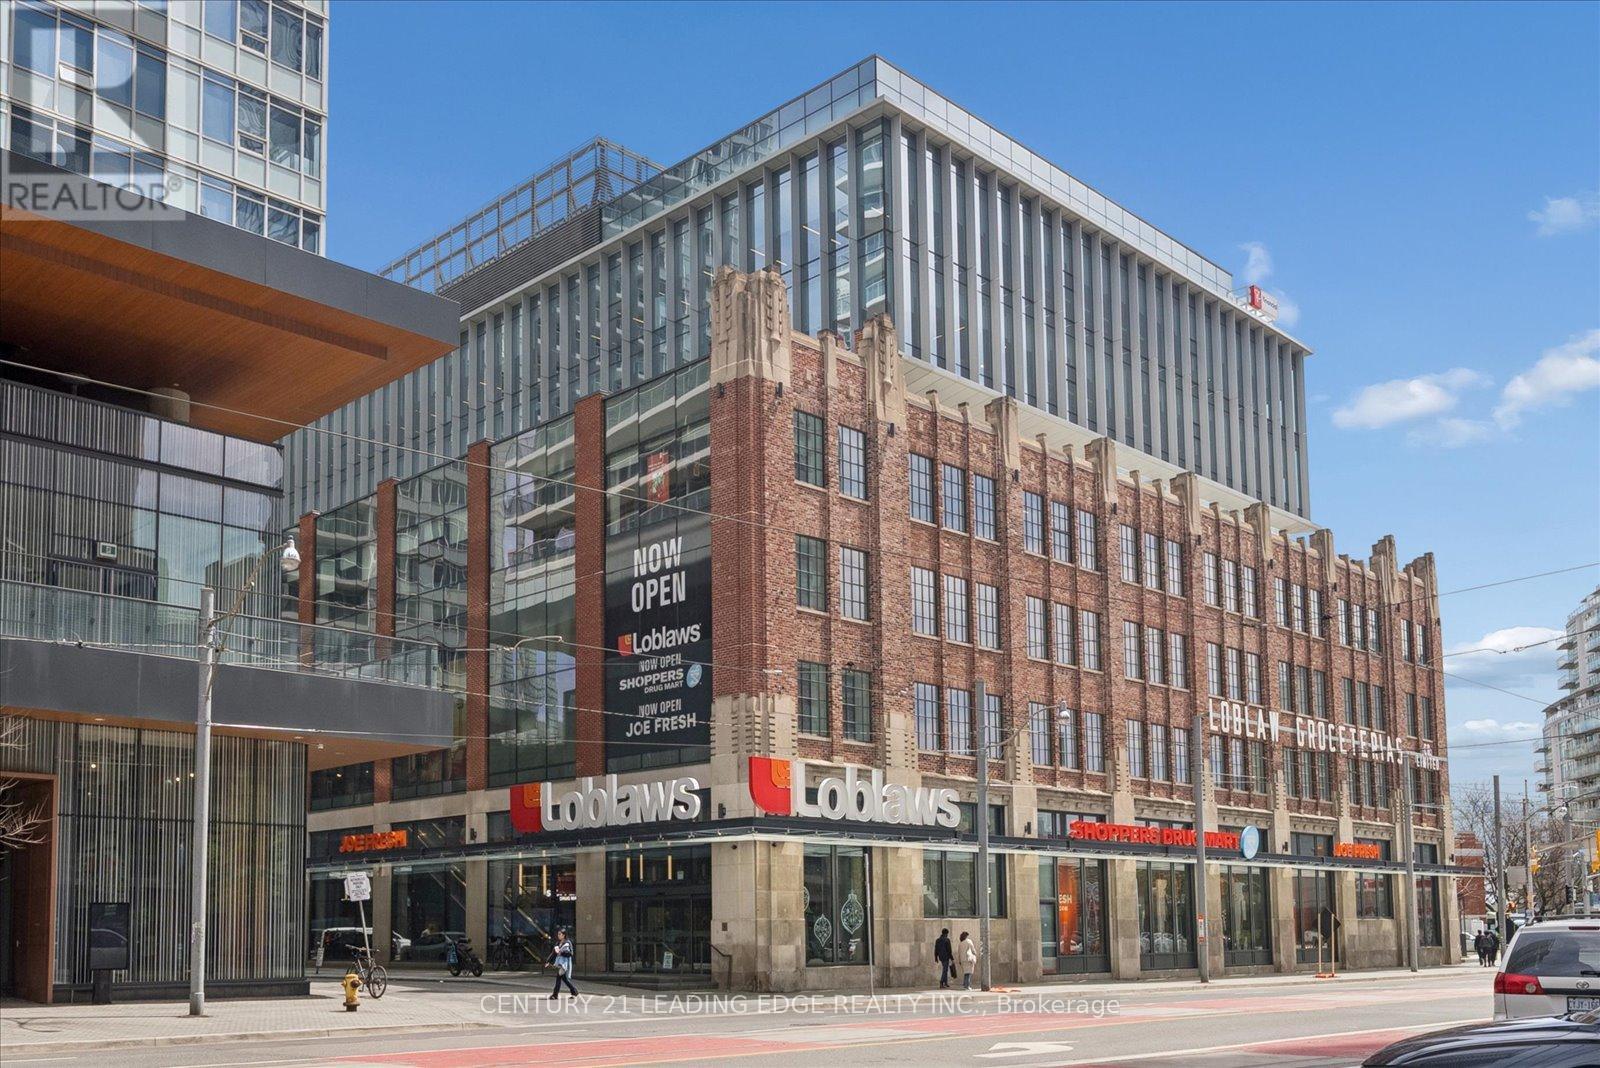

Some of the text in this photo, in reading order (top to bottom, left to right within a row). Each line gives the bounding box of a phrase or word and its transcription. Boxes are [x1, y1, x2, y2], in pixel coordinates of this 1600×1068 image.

[633, 536, 682, 578] NOW
[631, 570, 686, 613] OPEN
[632, 623, 701, 654] Loblaws
[639, 653, 682, 672] NOW OPEN
[619, 668, 684, 691] SHOPPERS
[644, 680, 684, 694] DRUG MART
[639, 698, 682, 718] NOW OPEN
[625, 712, 697, 738] JOE FRESH
[1208, 698, 1403, 765] LOBLAW GROCETERIAS
[540, 773, 701, 831] Loblaws
[792, 758, 962, 828] Loblaws
[1068, 820, 1161, 845] SHOPPERS
[1204, 831, 1241, 851] MART
